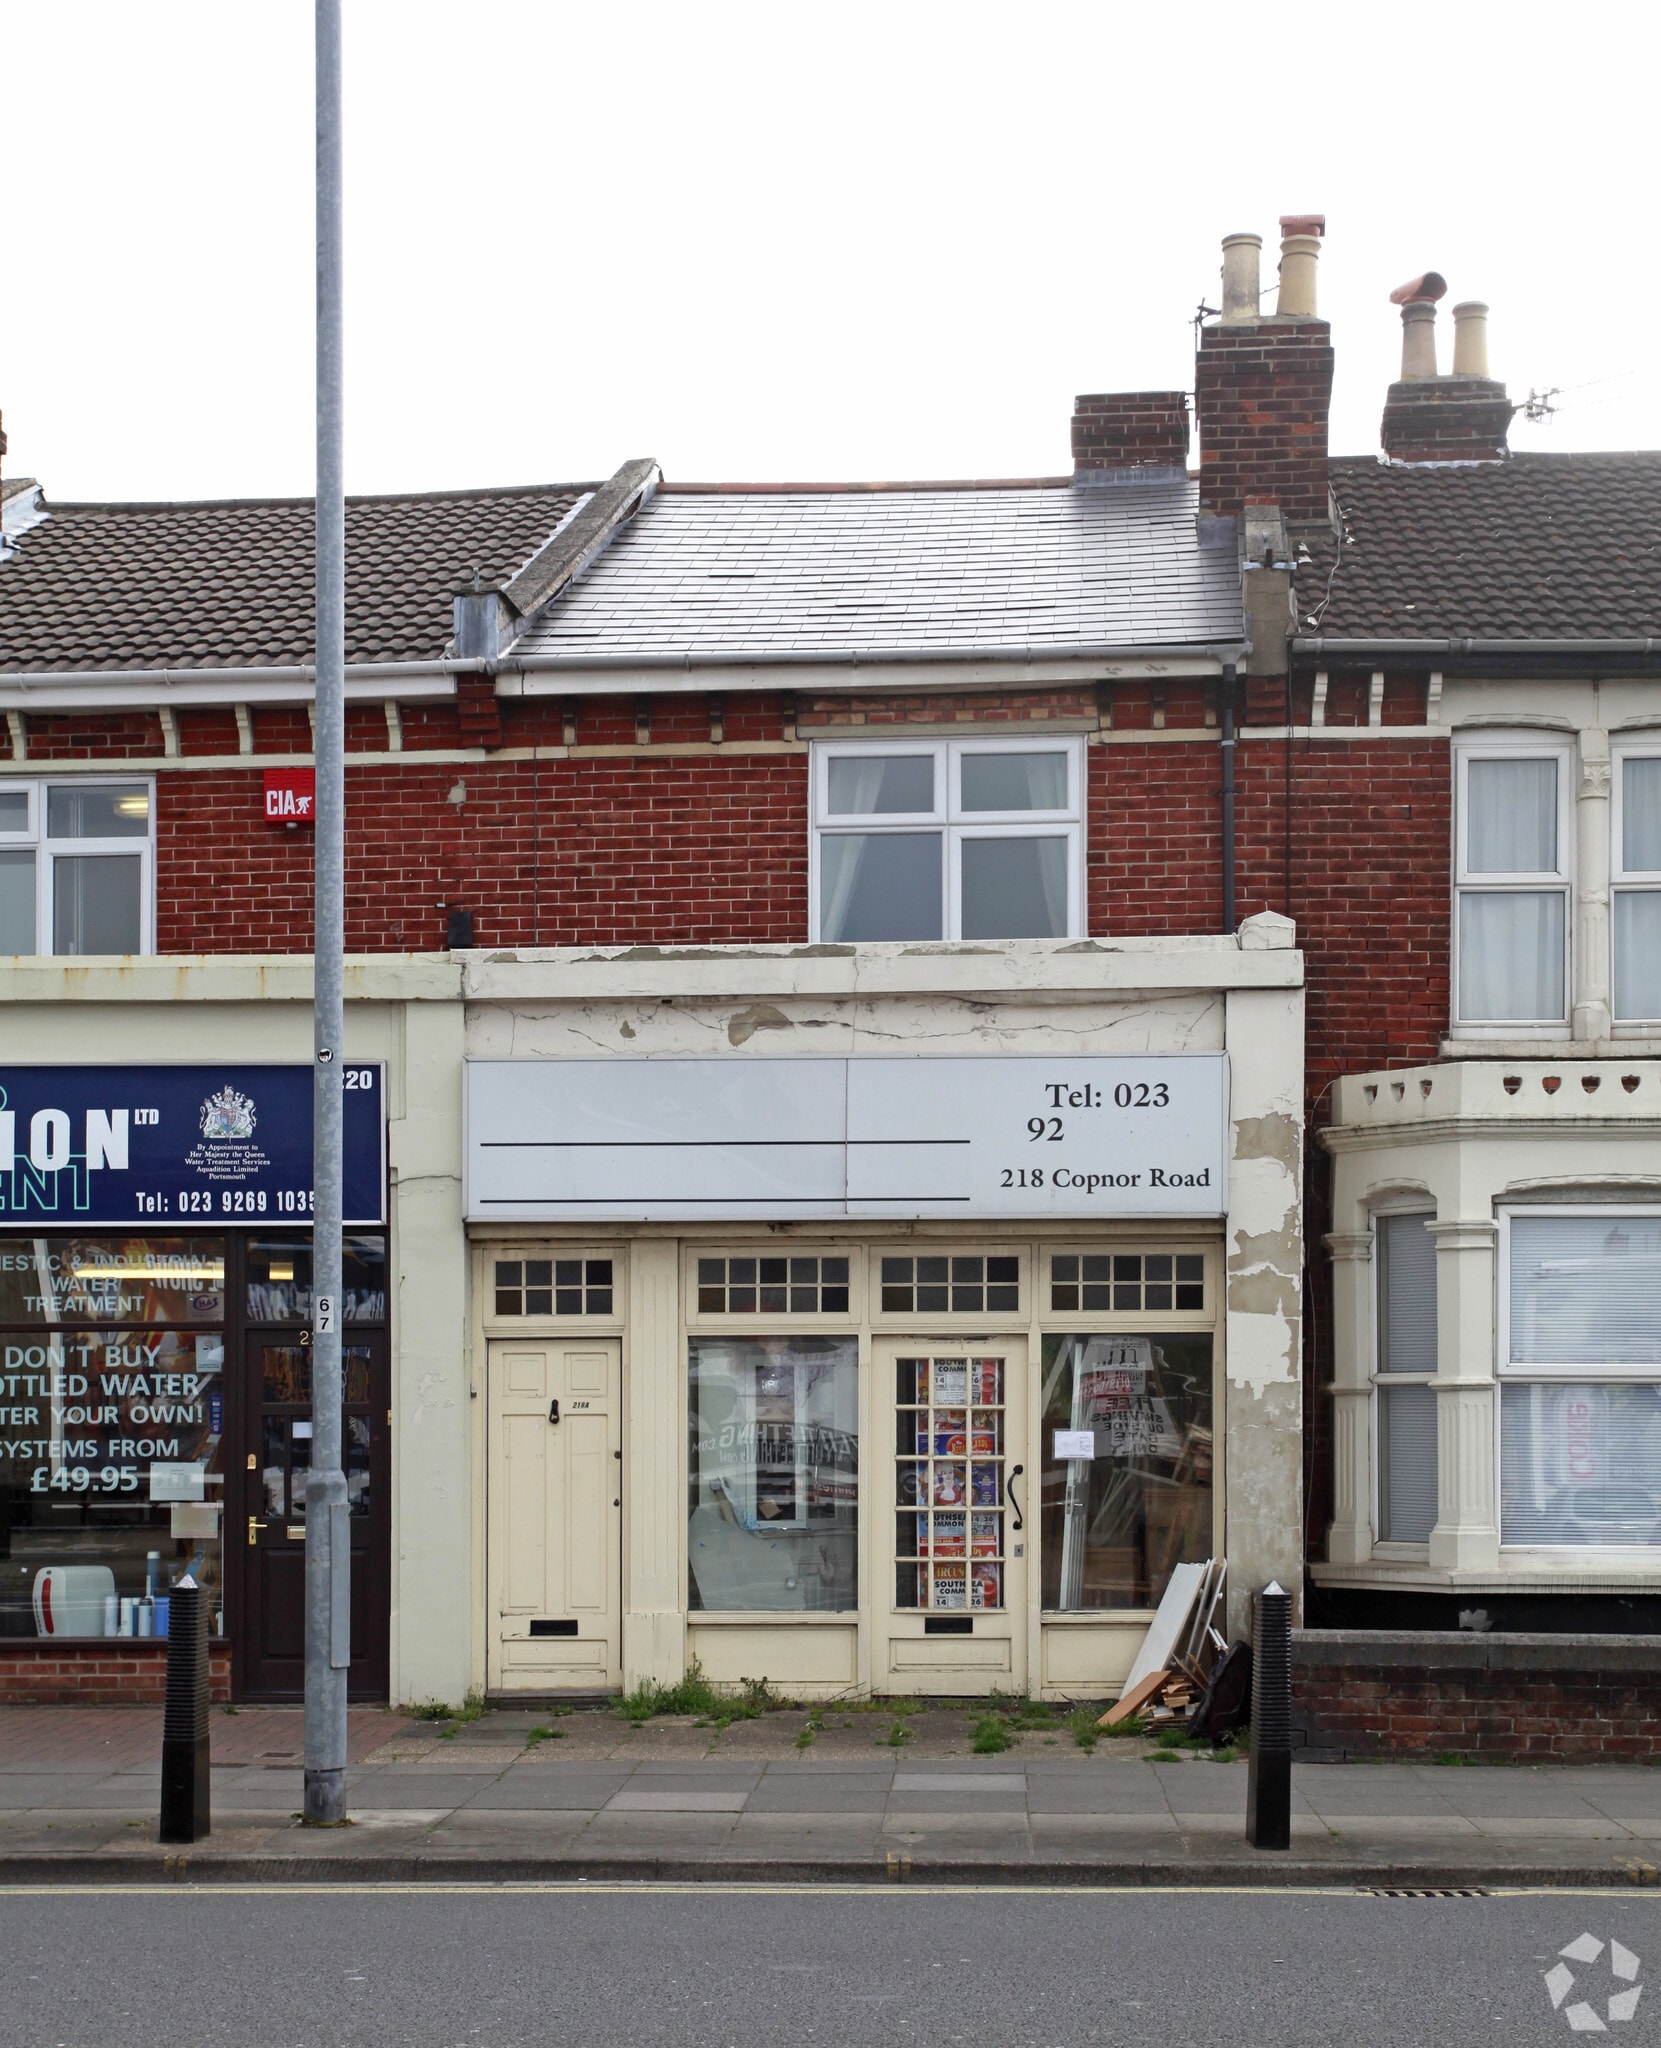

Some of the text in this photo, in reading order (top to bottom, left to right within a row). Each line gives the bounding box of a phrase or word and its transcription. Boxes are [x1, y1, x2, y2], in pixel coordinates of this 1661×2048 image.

[266, 790, 296, 816] CIA
[342, 1070, 373, 1090] 20
[1045, 1083, 1170, 1108] Tel: 023
[134, 1108, 160, 1125] LTD
[1027, 1117, 1065, 1142] 92
[197, 1143, 206, 1151] By
[208, 1143, 250, 1151] Appointment
[204, 1151, 230, 1159] Majesty
[244, 1151, 265, 1159] Queen
[196, 1166, 231, 1174] Aquadition
[1000, 1167, 1211, 1195] 218 Copnor Road
[135, 1192, 169, 1213] Tel:
[178, 1191, 212, 1213] 023
[222, 1191, 267, 1212] 9269
[0, 1254, 207, 1271] ESTIC & INDUSTRIAL
[51, 1276, 119, 1292] WATER
[23, 1295, 145, 1312] TREATMENT
[105, 1345, 161, 1368] BUY
[0, 1373, 200, 1397] TTLED WATER
[51, 1405, 119, 1425] YOUR
[130, 1404, 203, 1424] OWN!
[0, 1438, 179, 1459] YSTEMS FROM
[30, 1466, 138, 1493] £49.95
[936, 1566, 965, 1577] IRCUS
